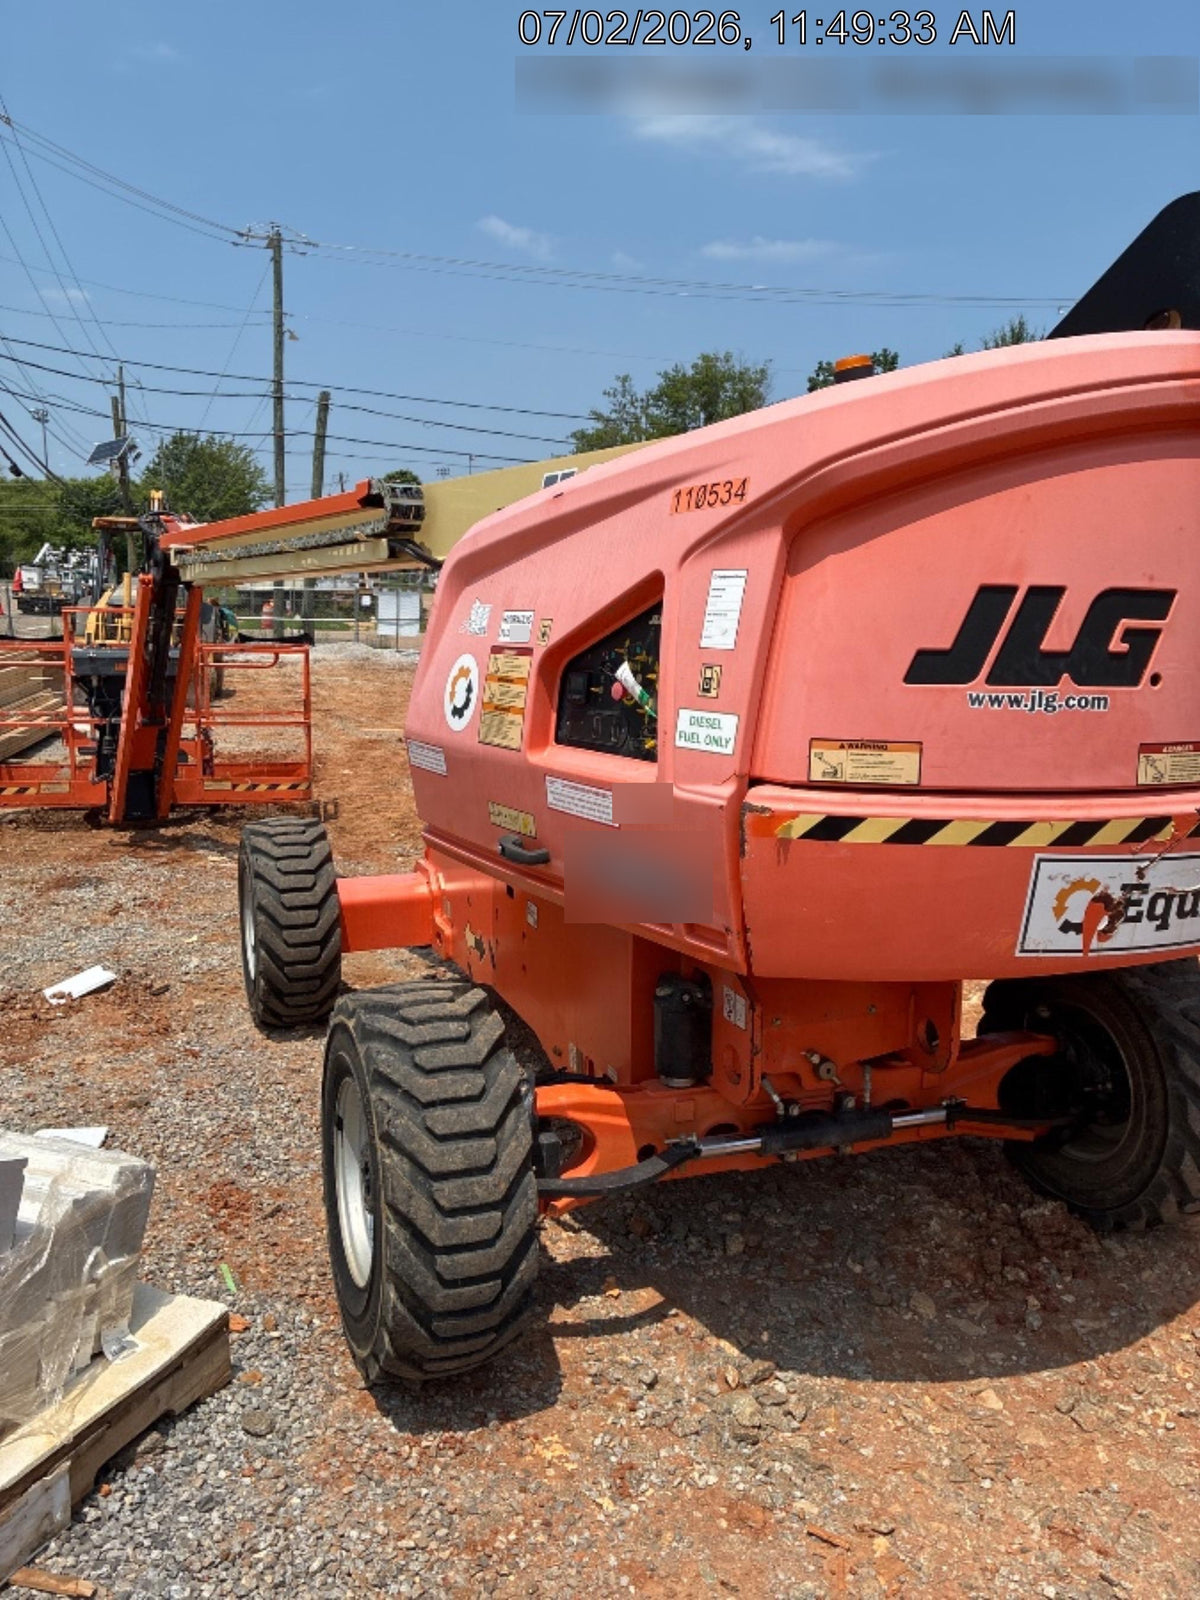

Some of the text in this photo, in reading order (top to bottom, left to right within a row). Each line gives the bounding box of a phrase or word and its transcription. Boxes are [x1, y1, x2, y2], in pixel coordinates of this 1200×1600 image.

[672, 477, 749, 513] 110534
[967, 688, 1110, 714] www.jlg.com
[689, 715, 723, 730] DIESEL
[678, 731, 732, 749] FUEL ONLY
